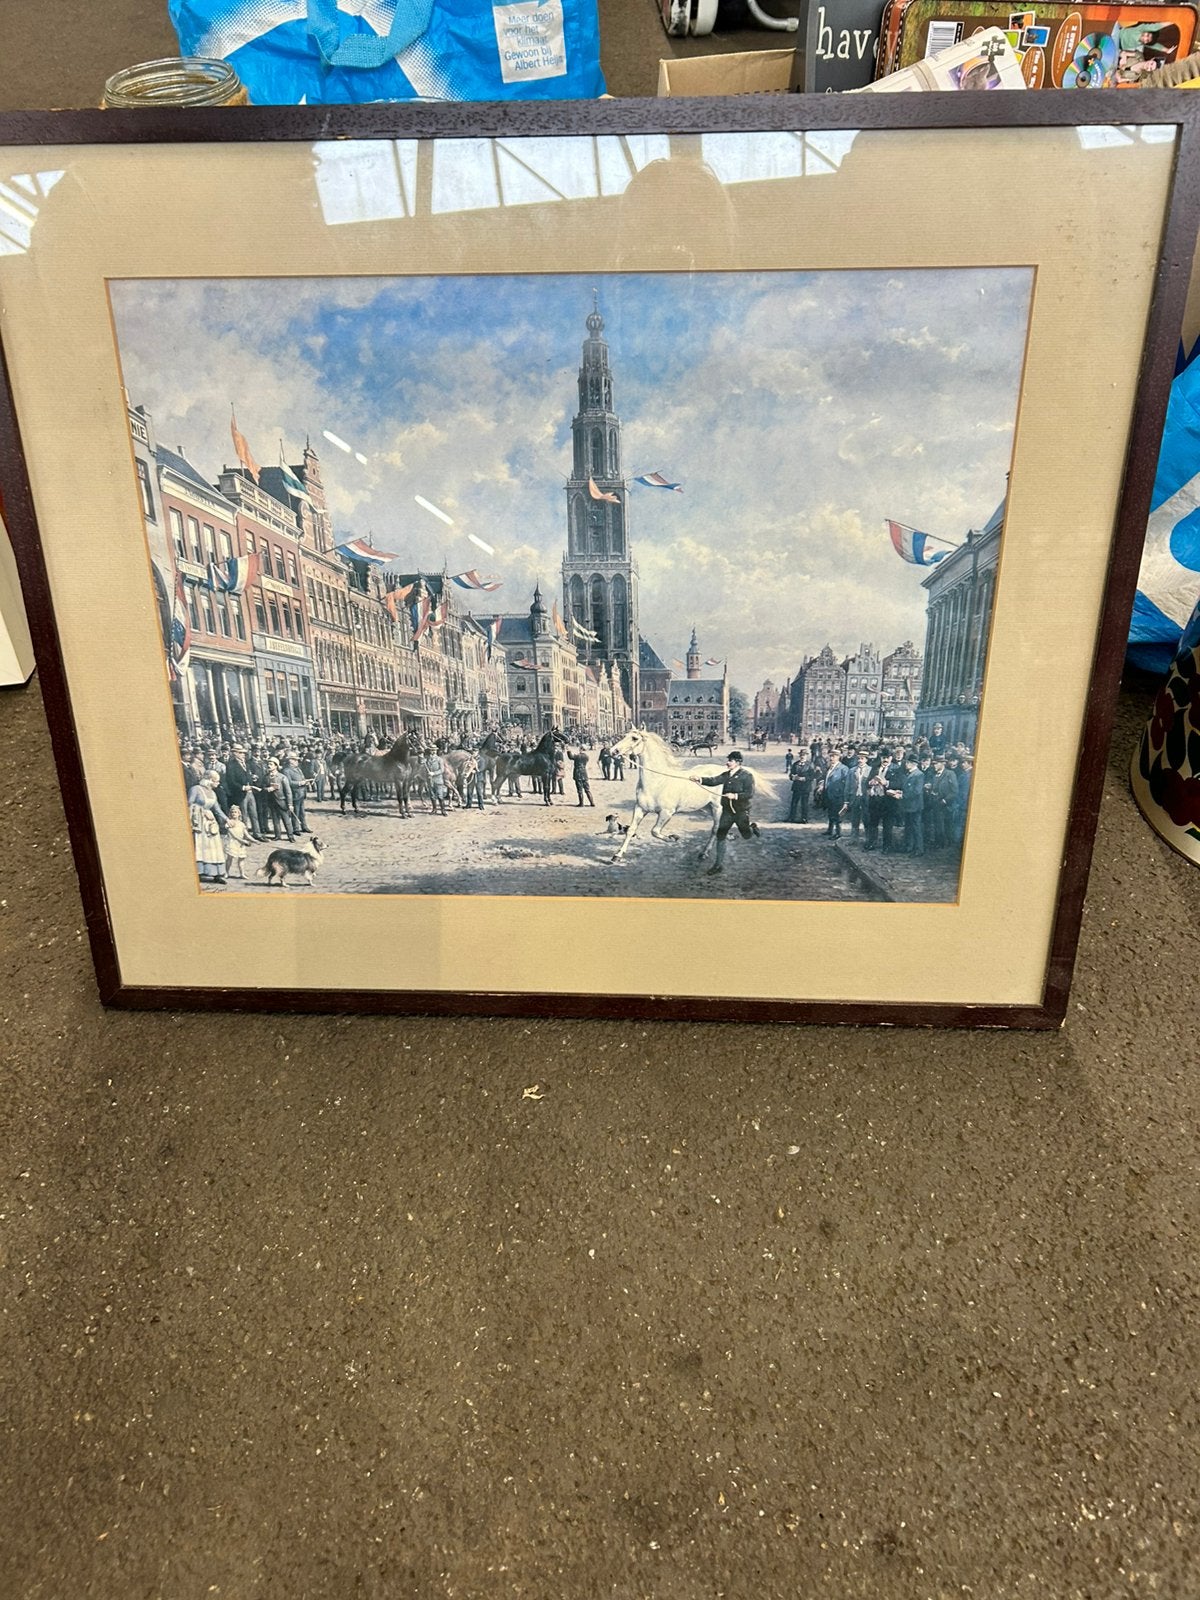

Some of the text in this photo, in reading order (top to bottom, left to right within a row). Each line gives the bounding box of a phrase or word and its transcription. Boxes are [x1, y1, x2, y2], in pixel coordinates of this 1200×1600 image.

[532, 12, 555, 22] doen
[525, 25, 540, 34] het
[504, 45, 552, 61] Gewoon bij
[514, 58, 542, 71] Albert
